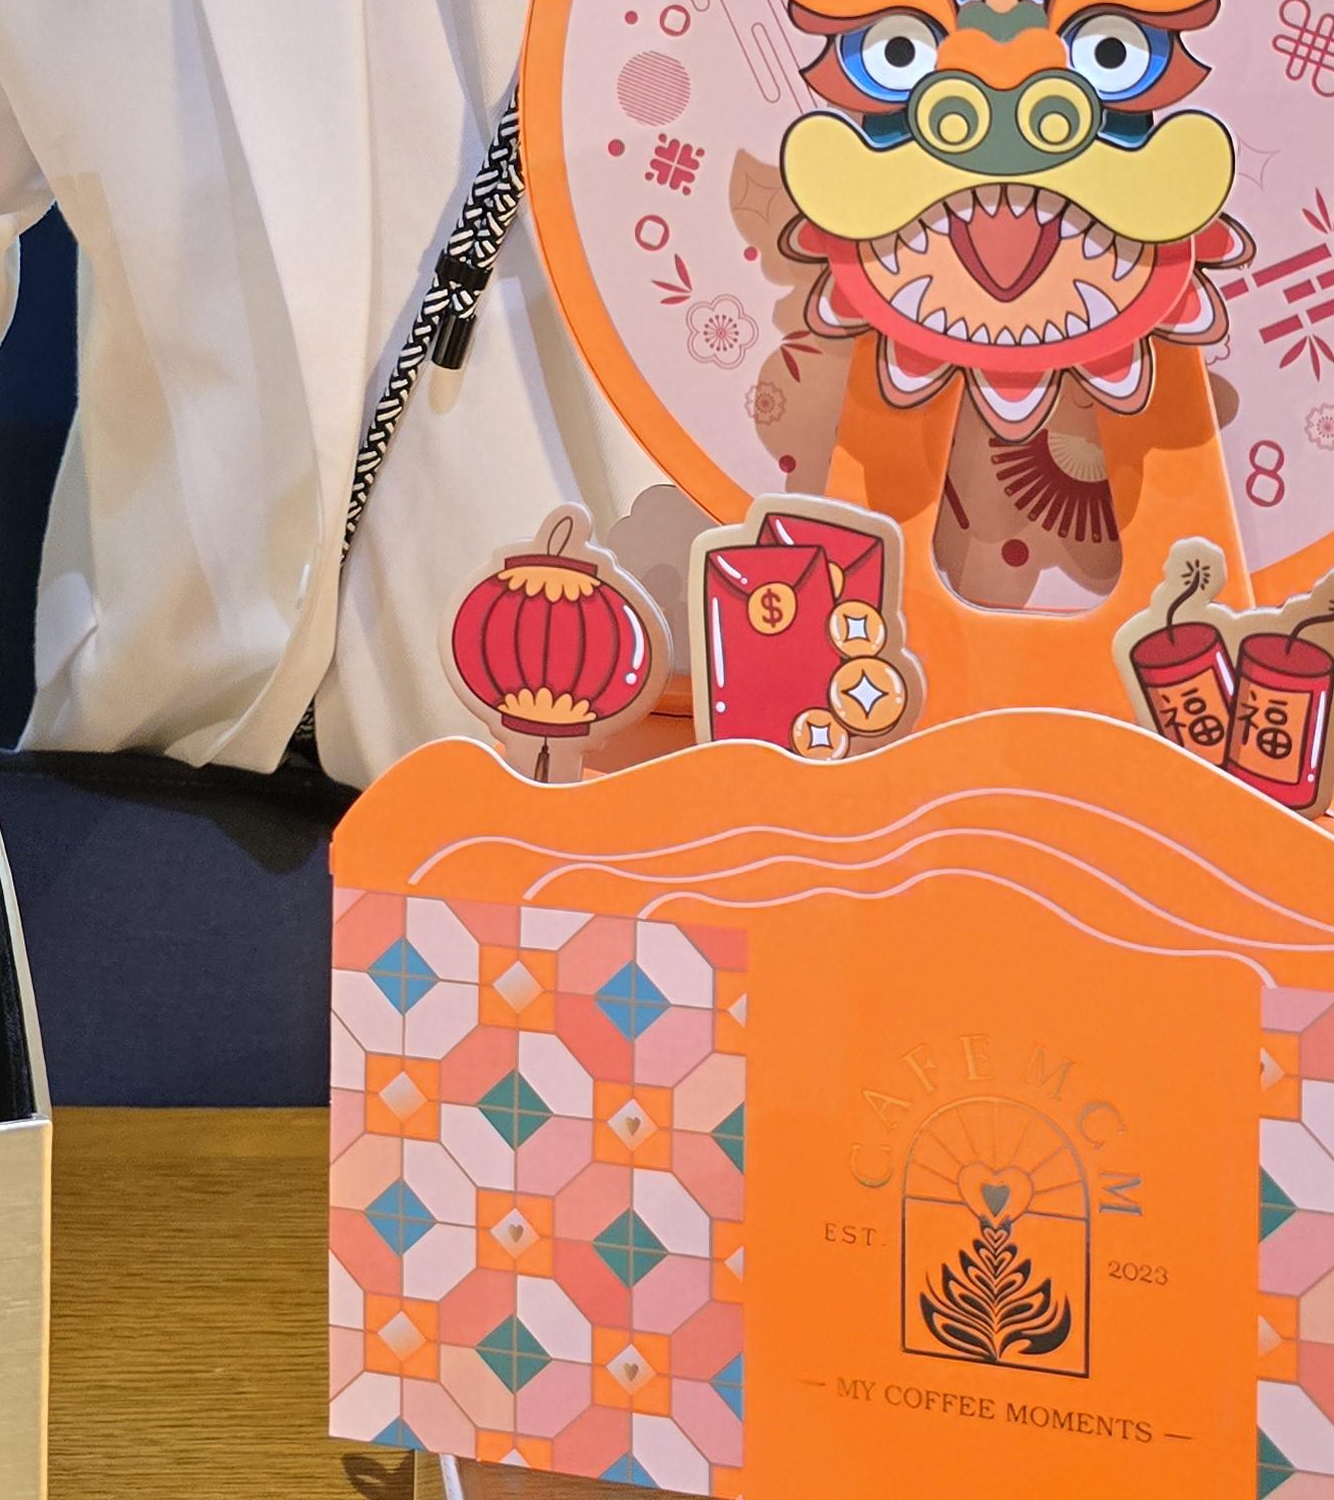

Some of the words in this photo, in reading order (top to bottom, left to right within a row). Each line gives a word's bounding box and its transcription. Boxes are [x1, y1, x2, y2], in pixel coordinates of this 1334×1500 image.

[1159, 687, 1225, 747] 福
[1237, 689, 1293, 759] 福
[1108, 1260, 1169, 1285] 2023
[836, 1376, 876, 1401] MY
[884, 1384, 995, 1420] COFFEE
[1006, 1401, 1153, 1443] MOMENTS
